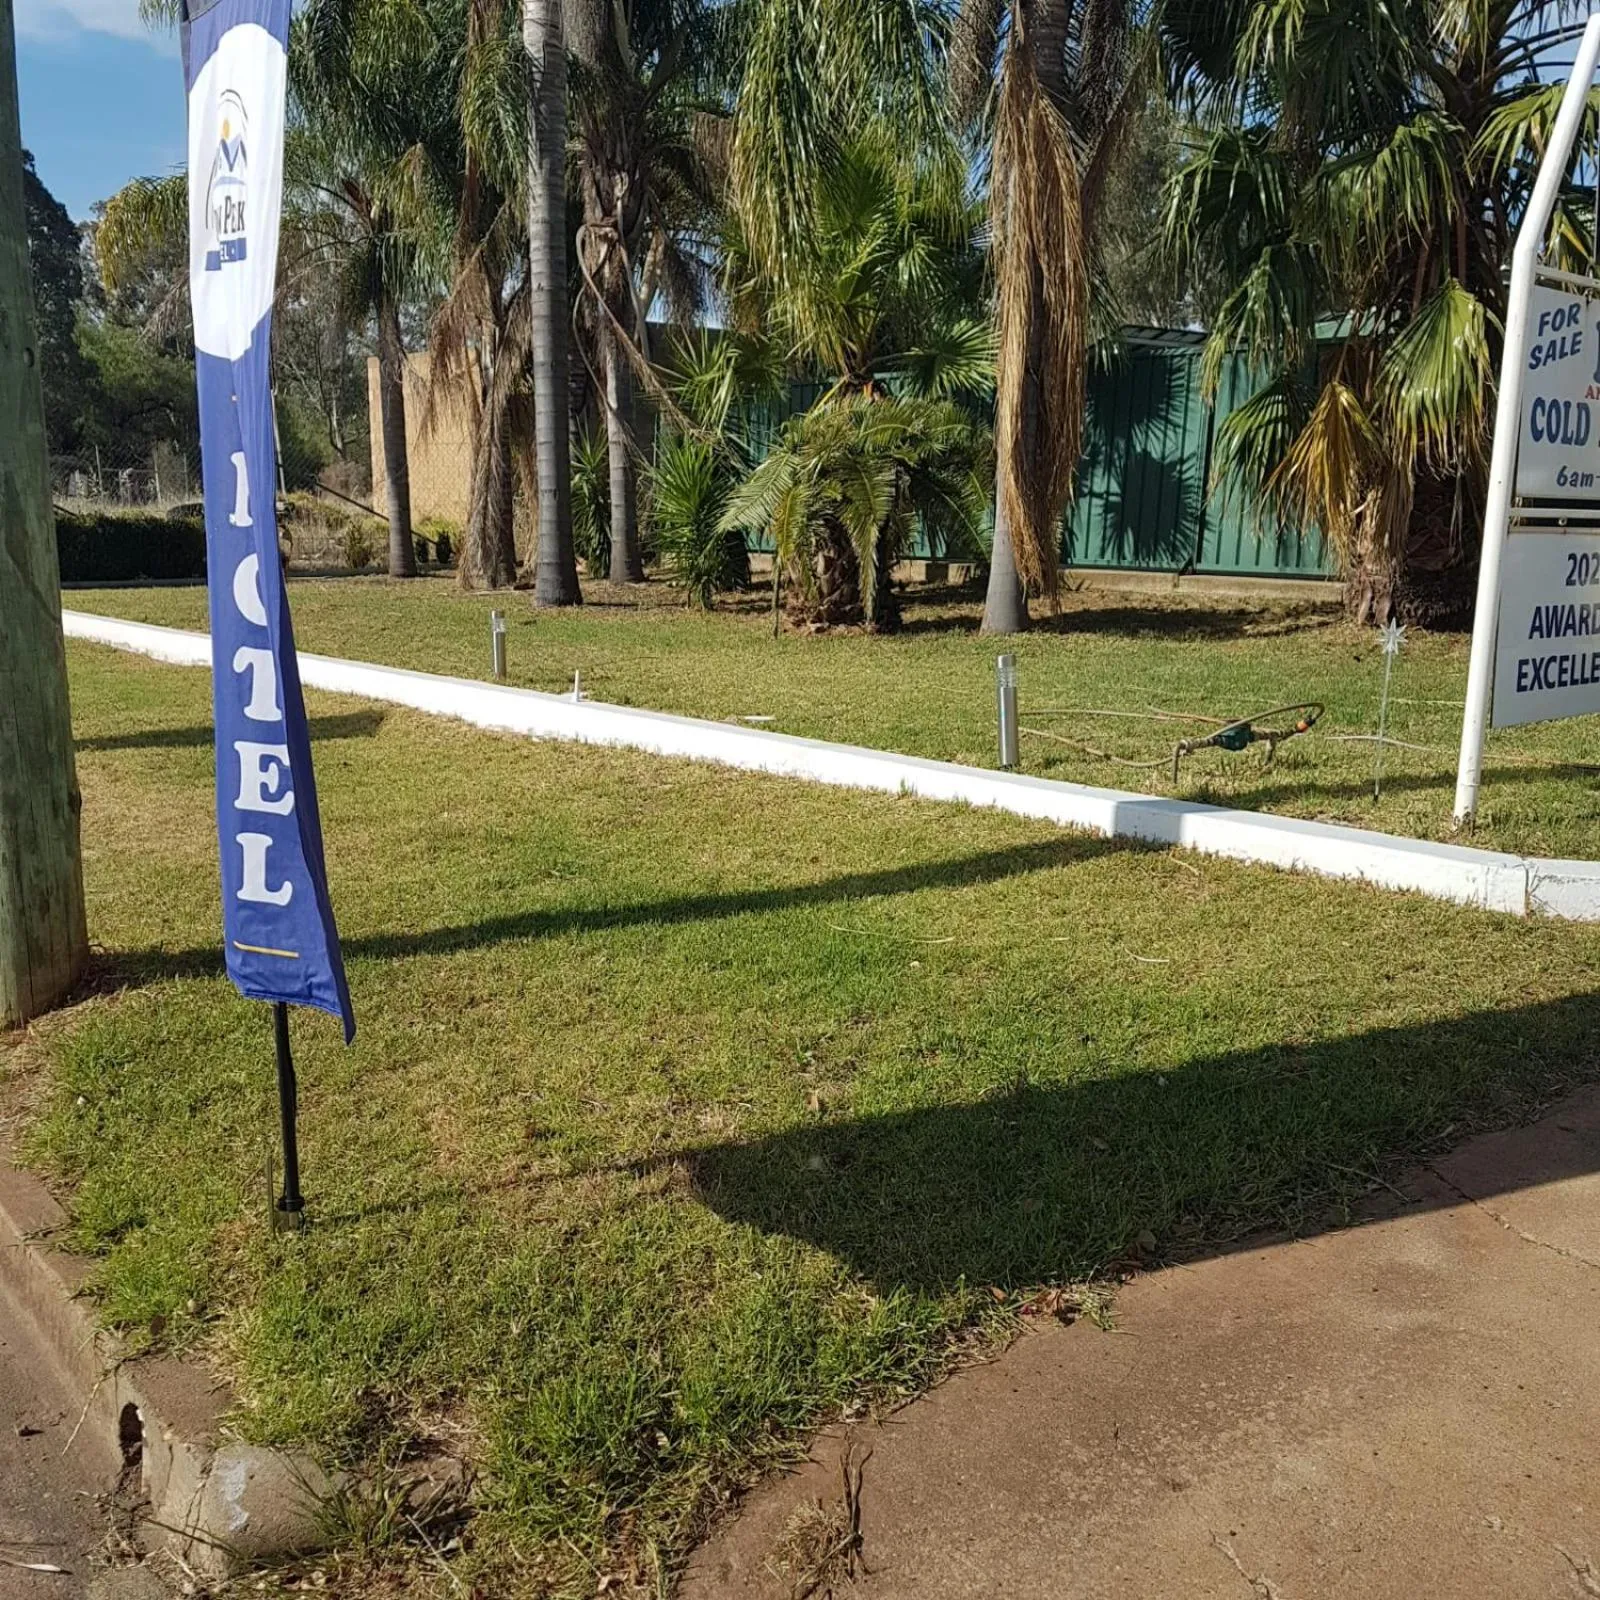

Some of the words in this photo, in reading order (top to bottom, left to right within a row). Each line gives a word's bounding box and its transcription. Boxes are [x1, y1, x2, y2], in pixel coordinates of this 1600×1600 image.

[1538, 303, 1581, 337] FOR
[1528, 331, 1583, 370] SALE
[1530, 396, 1591, 447] COLD
[1565, 552, 1600, 587] 202
[1528, 603, 1600, 640] AWARD
[1516, 651, 1600, 693] EXCELLE
